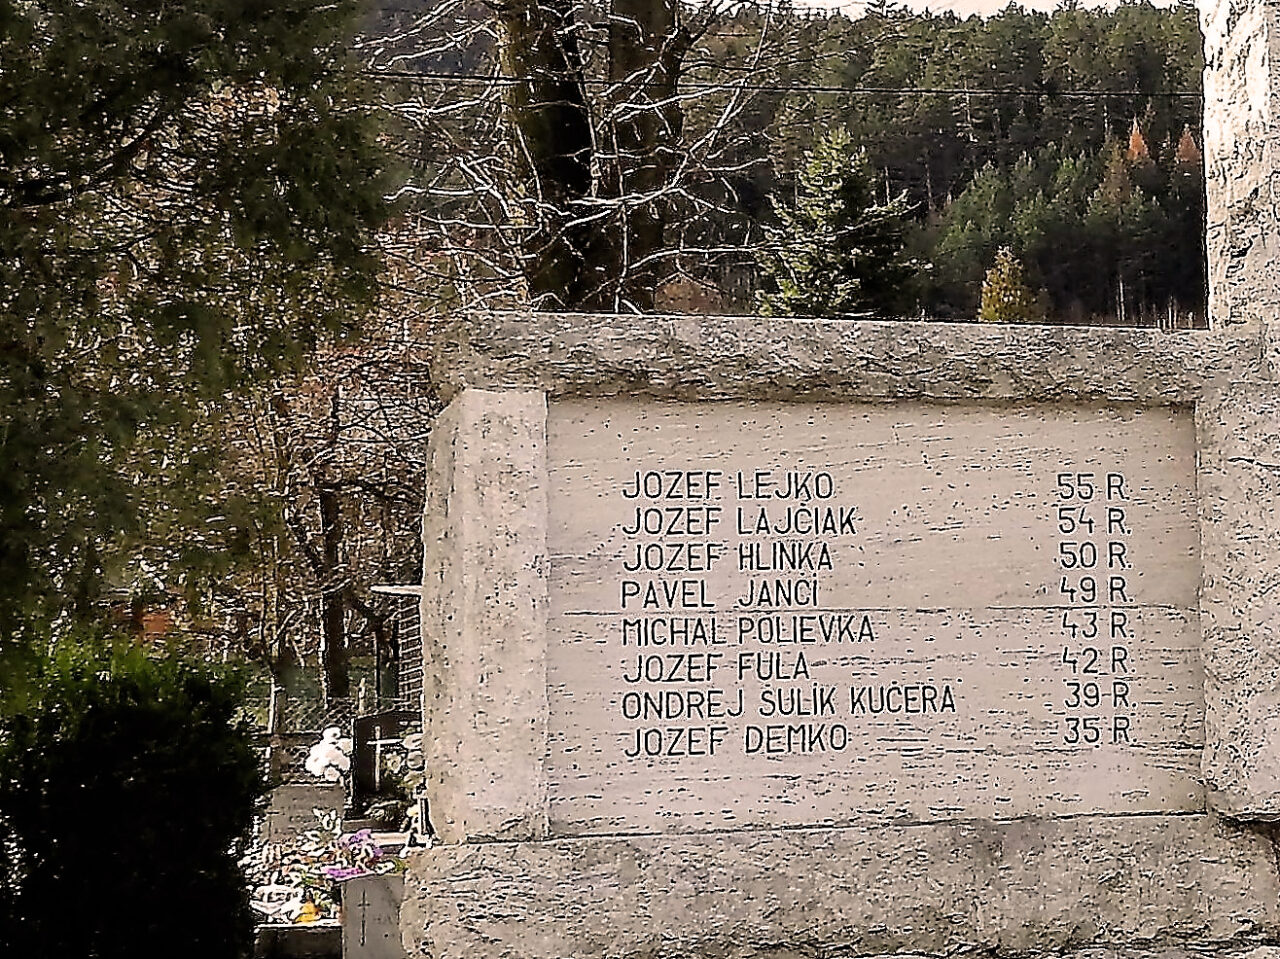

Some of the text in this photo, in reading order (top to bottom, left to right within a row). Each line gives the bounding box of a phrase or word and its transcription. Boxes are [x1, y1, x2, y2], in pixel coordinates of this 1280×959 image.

[622, 471, 723, 499] JOZEF
[737, 471, 834, 500] LEJKO
[1057, 473, 1094, 499] 55
[622, 503, 1131, 535] JOZEF LAJČIAK 54 R.
[623, 542, 1132, 570] JOZEF HLINKA 50 R.
[621, 580, 715, 608] PAVEL
[1061, 576, 1096, 602] 49
[1110, 576, 1134, 602] R.
[622, 612, 1135, 646] MICHAL POLIEVKA 43 R.
[623, 646, 1136, 683] JOZEF FULA 42 R.
[622, 690, 742, 719] ONDREJ
[850, 681, 956, 714] KUČERA
[1065, 682, 1099, 707] 39
[1113, 681, 1137, 707] R.
[624, 716, 1137, 756] JOZEF DEMKO 35 R.
